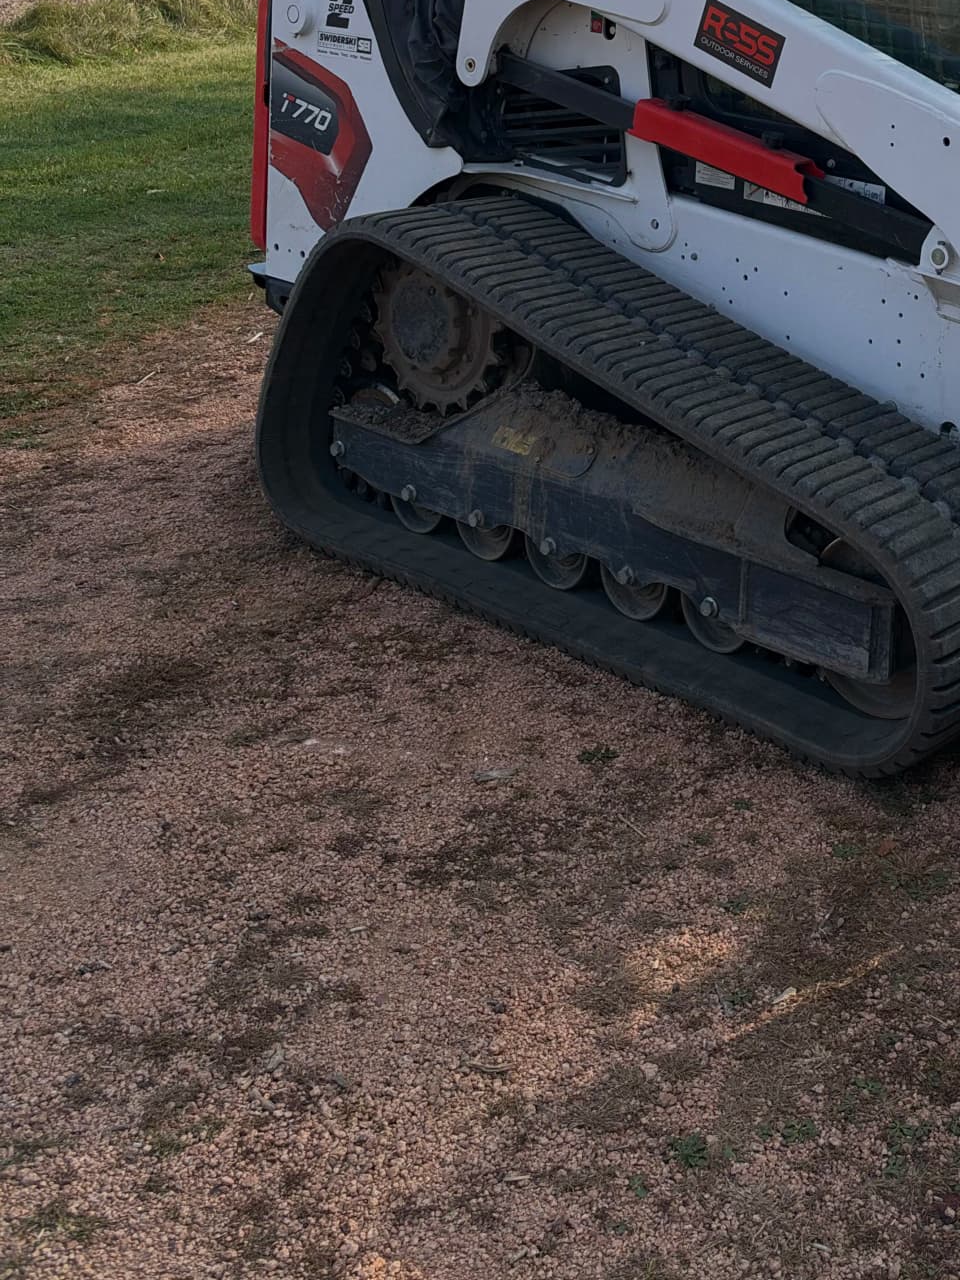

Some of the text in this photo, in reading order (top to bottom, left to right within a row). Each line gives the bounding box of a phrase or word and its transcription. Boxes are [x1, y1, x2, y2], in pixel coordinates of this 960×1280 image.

[328, 2, 355, 14] SPEED
[319, 33, 357, 46] SWIDERSKI
[700, 36, 770, 80] OUTDOOR SERVICES
